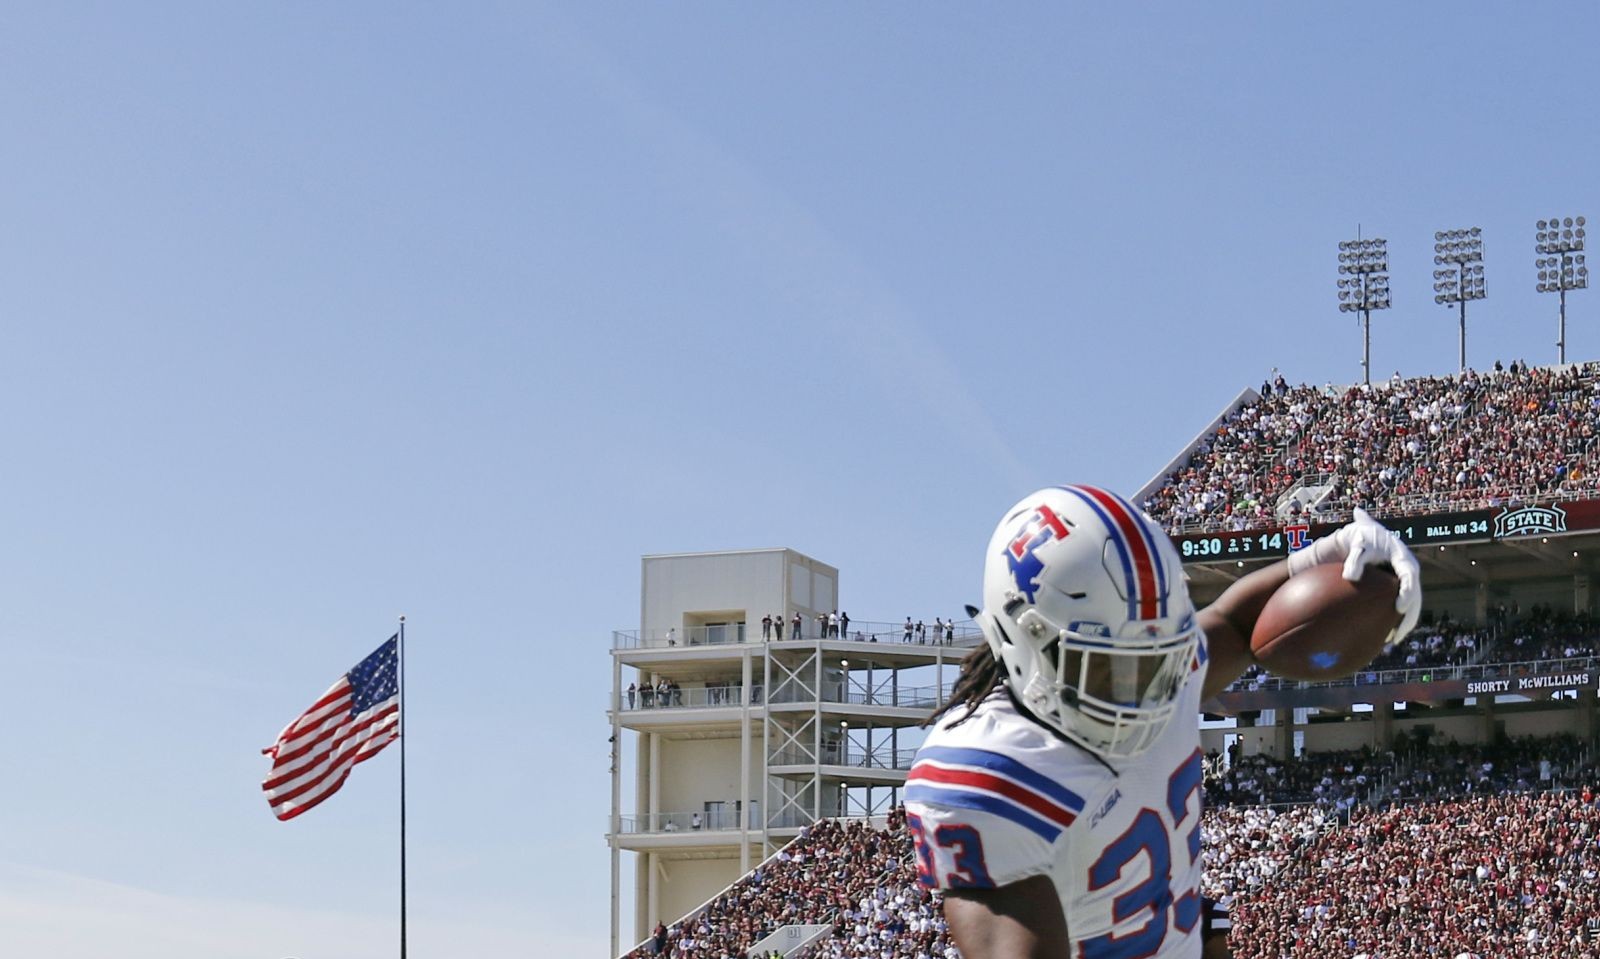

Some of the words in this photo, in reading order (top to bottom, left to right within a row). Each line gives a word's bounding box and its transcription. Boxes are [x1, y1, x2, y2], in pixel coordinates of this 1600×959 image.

[1427, 525, 1450, 537] BALL
[1454, 524, 1467, 534] ON
[1469, 520, 1488, 533] 34
[1507, 512, 1552, 530] STATE
[1182, 538, 1221, 556] 9:30
[1243, 543, 1250, 552] 3
[1259, 533, 1281, 550] 14
[1467, 680, 1510, 693] SHORTY
[1518, 673, 1589, 690] McWILLIAMS
